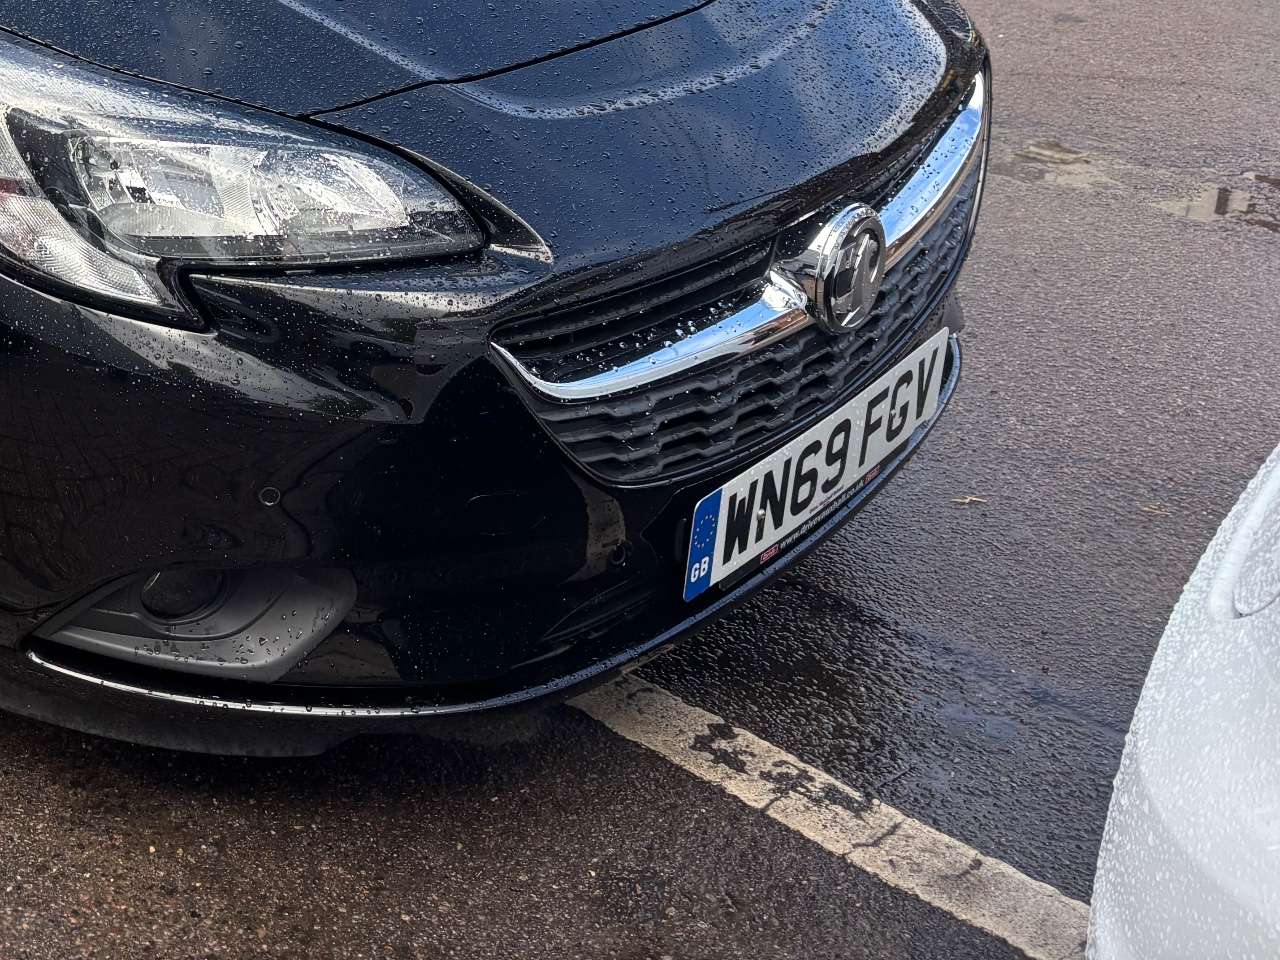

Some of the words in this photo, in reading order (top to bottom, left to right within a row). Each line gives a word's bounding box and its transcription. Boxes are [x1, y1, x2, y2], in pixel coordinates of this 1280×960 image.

[722, 418, 852, 566] WN69
[858, 347, 939, 469] FGV
[690, 556, 710, 583] GB
